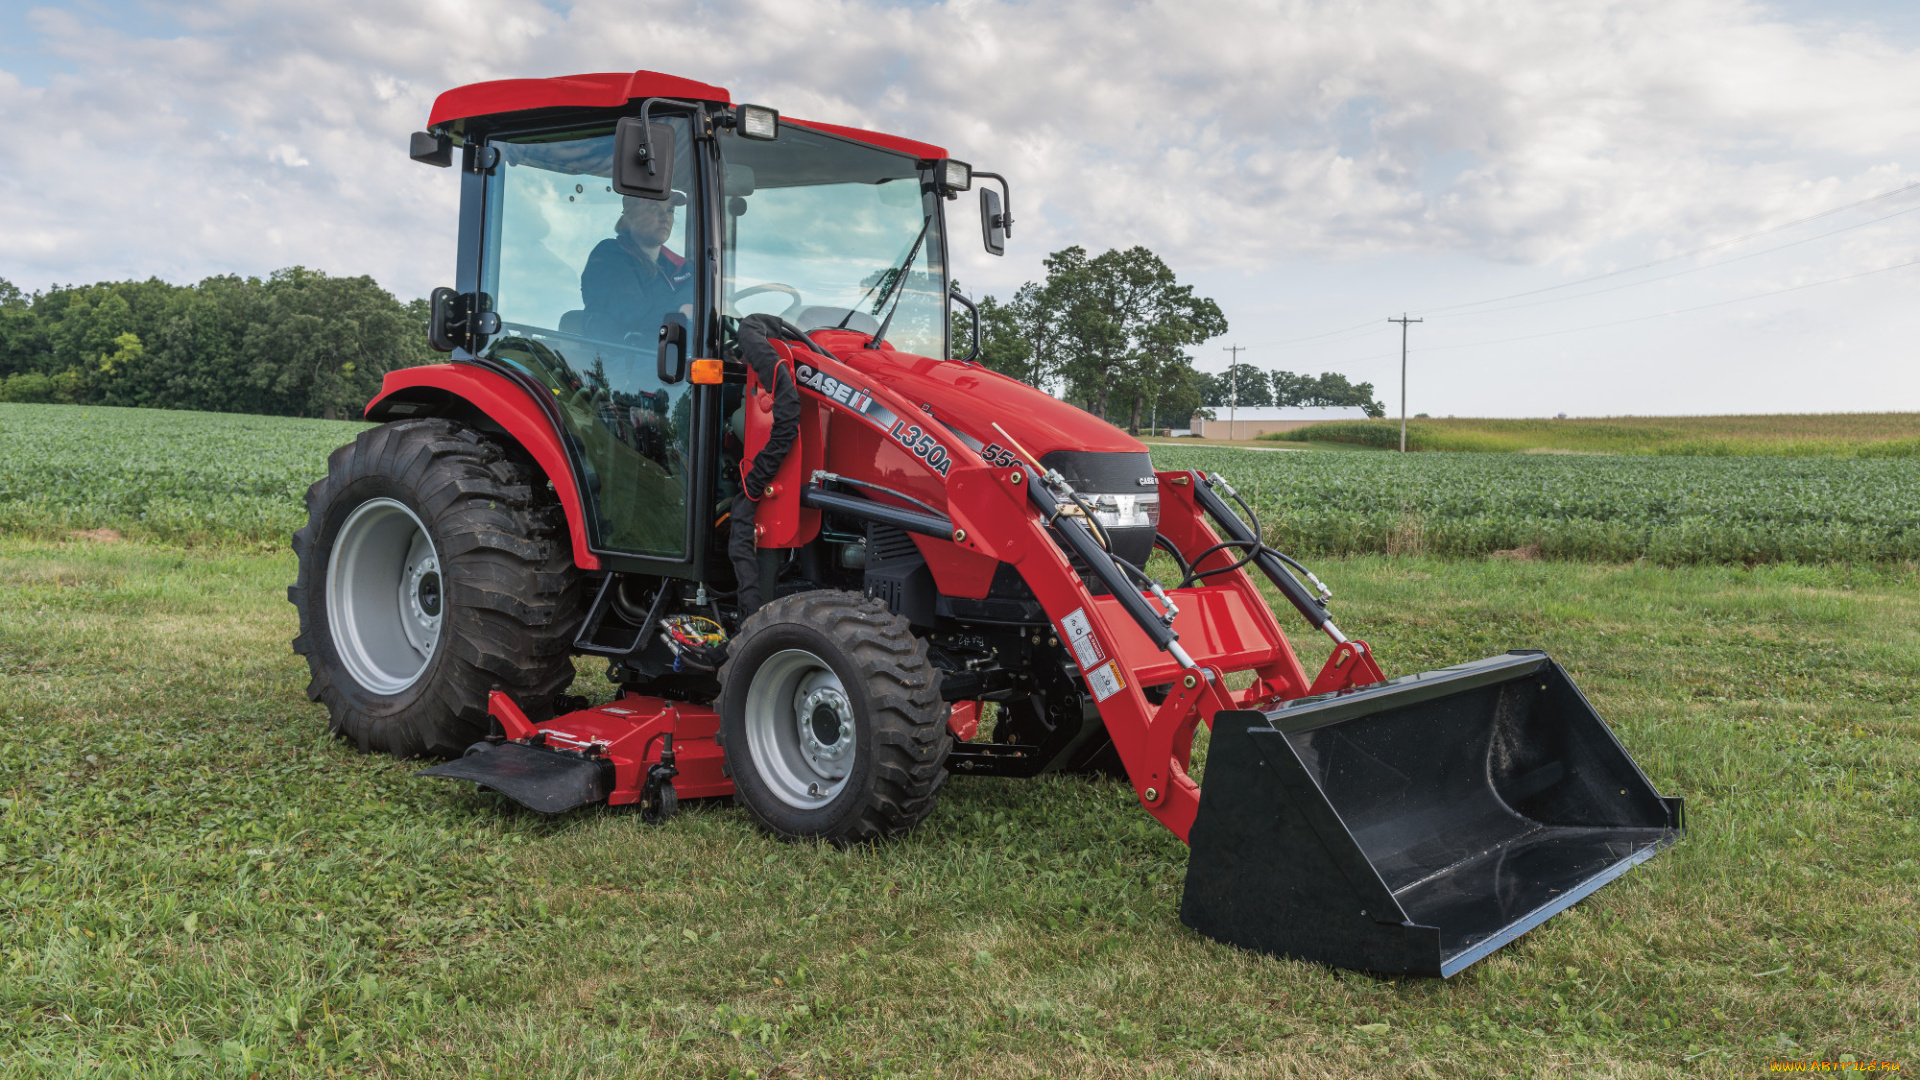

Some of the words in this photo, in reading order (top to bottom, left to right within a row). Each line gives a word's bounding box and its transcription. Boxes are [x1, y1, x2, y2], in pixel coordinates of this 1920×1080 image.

[796, 365, 853, 403] CASE
[890, 420, 952, 478] L350A
[1139, 477, 1155, 485] CASE
[1090, 637, 1103, 659] DANGER
